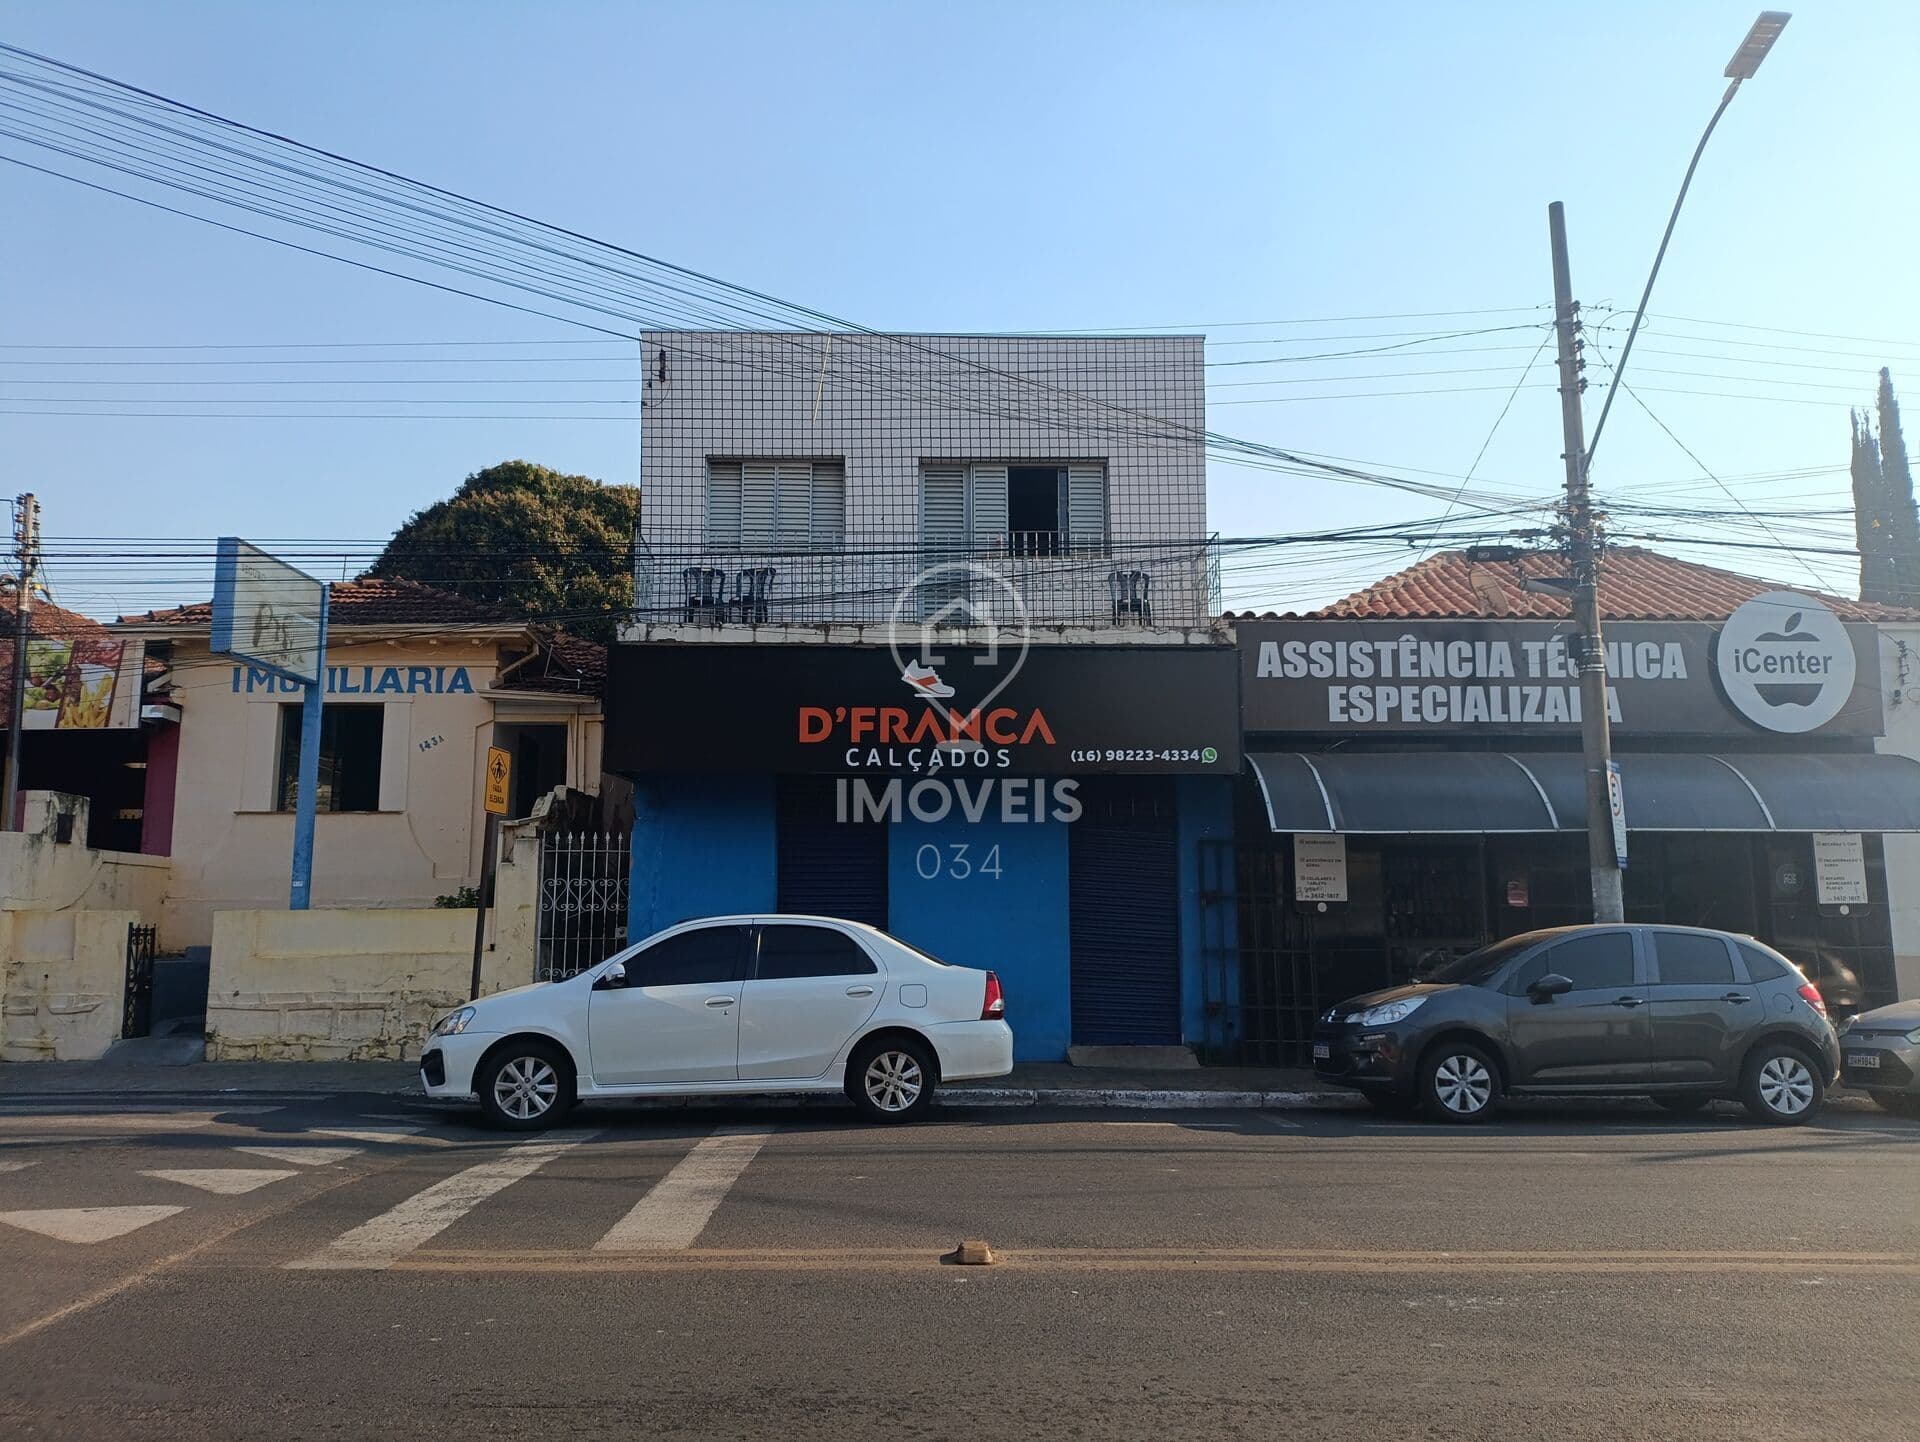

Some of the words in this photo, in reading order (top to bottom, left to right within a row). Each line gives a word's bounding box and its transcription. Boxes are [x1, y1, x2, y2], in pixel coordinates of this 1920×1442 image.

[1256, 634, 1515, 678] ASSISTÊNCIA
[1521, 634, 1688, 679] TÉNICA
[1734, 647, 1833, 674] iCenter
[799, 707, 1057, 744] D'FRANCA
[845, 748, 1011, 772] CALÇADOS
[1070, 749, 1101, 763] (16)
[1105, 749, 1200, 762] 98223-4334
